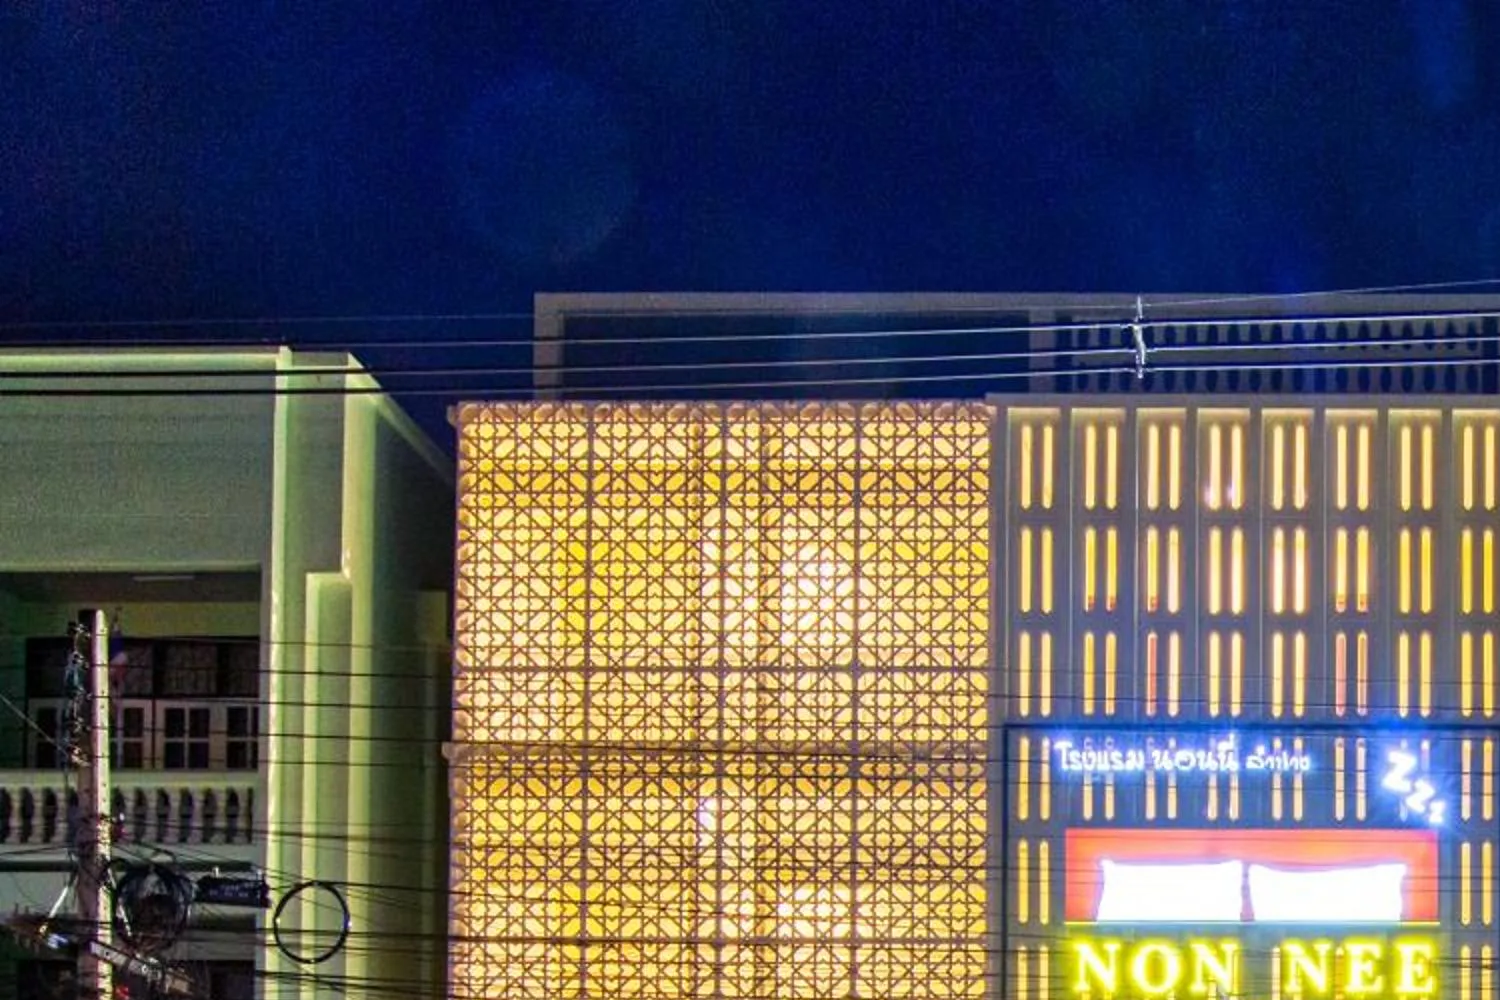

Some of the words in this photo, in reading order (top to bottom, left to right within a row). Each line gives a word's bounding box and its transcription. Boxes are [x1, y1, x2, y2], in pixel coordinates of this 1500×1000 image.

[1055, 739, 1145, 772] โรงแรม
[1152, 734, 1240, 772] นอนนี่
[1073, 942, 1240, 994] NON
[1284, 942, 1437, 994] NEE
